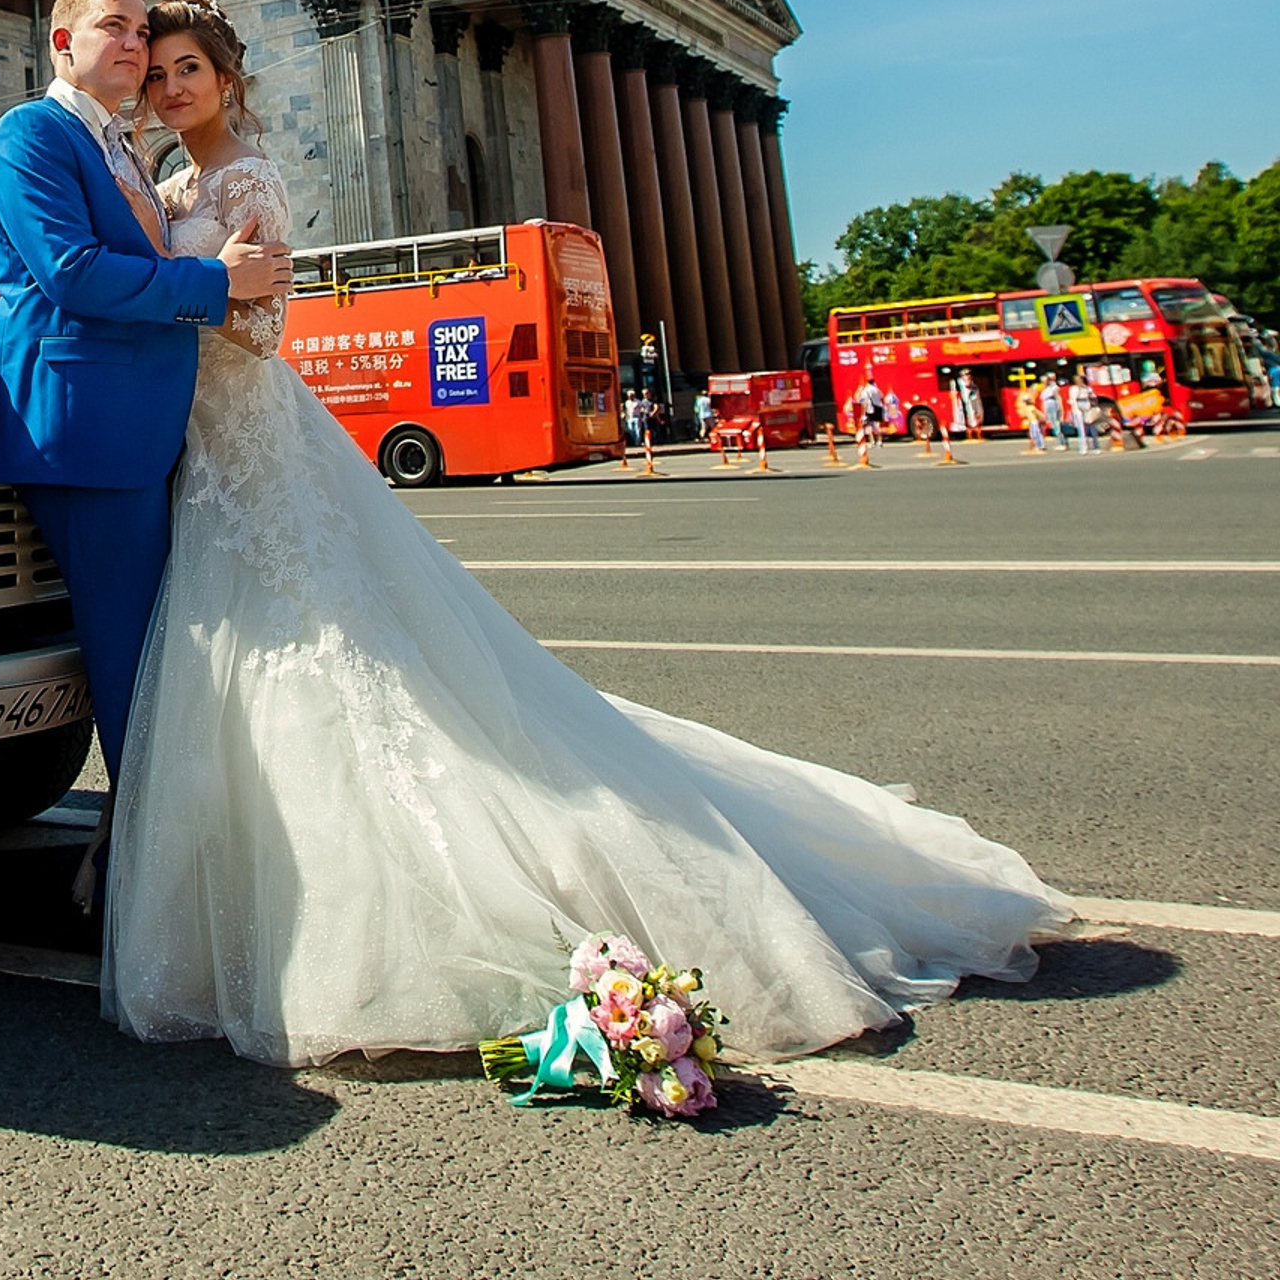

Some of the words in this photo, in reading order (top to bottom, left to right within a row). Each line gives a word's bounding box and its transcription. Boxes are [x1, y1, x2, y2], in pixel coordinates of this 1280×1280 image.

[291, 328, 416, 355] 中国游客专属优惠
[434, 324, 480, 344] SHOP
[434, 344, 469, 363] TAX
[436, 362, 478, 381] FREE
